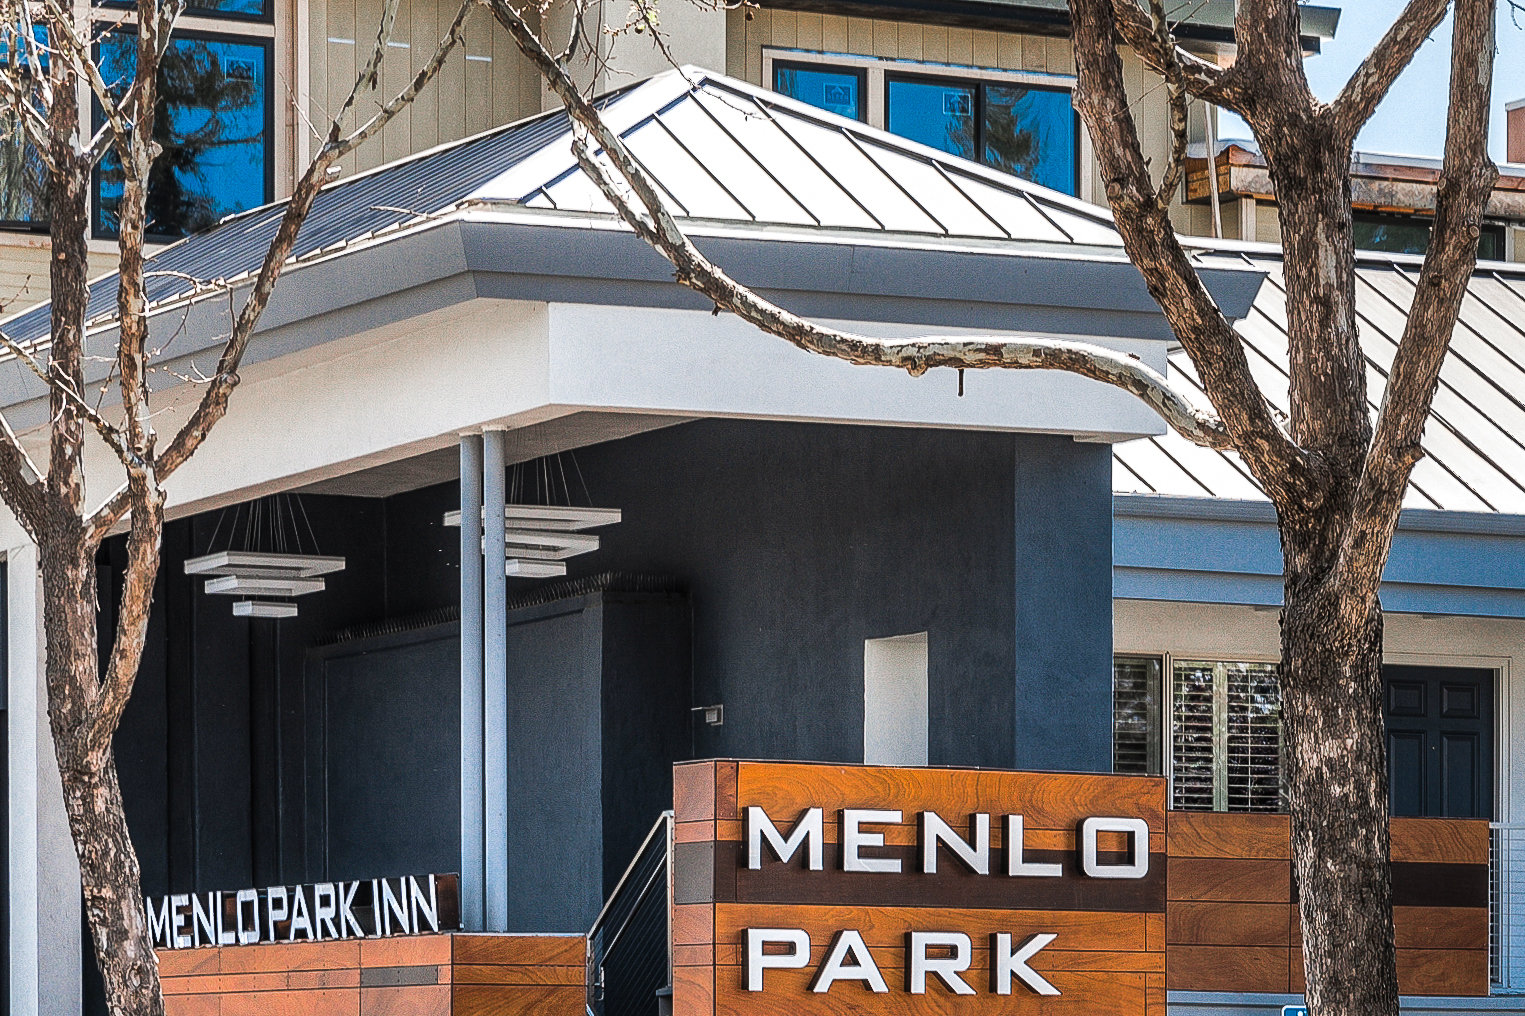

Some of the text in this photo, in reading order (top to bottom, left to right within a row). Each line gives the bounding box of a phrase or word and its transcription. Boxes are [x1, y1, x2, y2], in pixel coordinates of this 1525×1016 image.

[744, 805, 1149, 880] MENLO
[146, 873, 440, 949] MENLO PARK INN
[744, 928, 1063, 996] PARK
